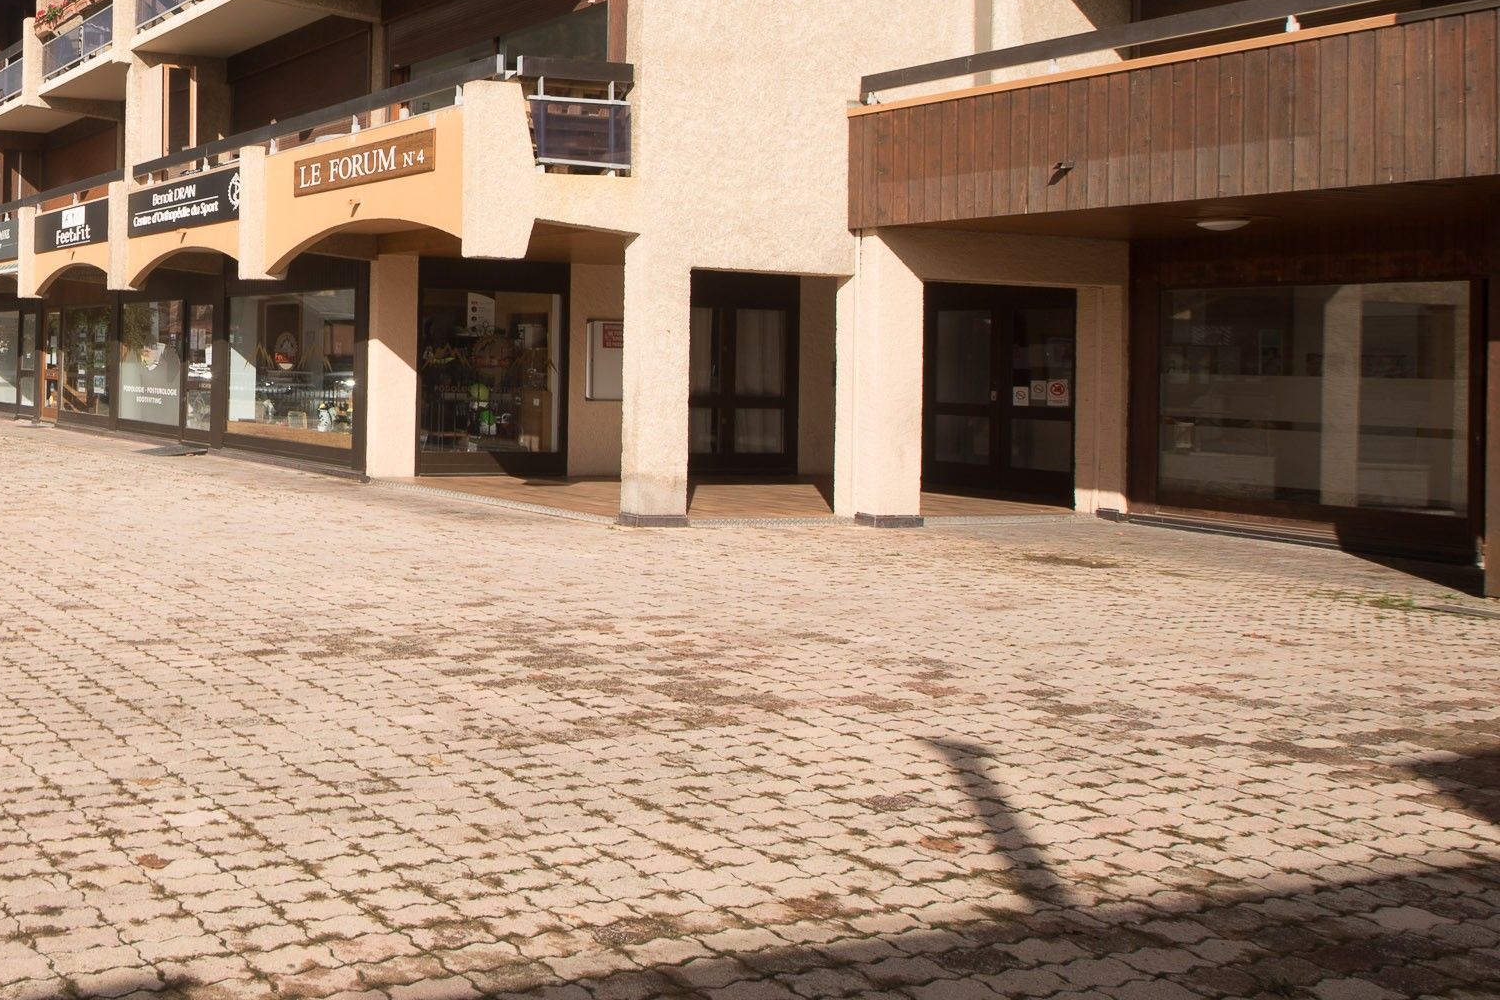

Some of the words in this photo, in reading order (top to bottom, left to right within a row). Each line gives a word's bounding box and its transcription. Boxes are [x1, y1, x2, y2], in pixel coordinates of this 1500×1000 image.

[299, 163, 322, 188] LE
[328, 145, 397, 182] FORUM
[174, 184, 196, 201] DRAN
[133, 216, 152, 227] Centre
[191, 205, 200, 216] du
[200, 201, 219, 216] Sport
